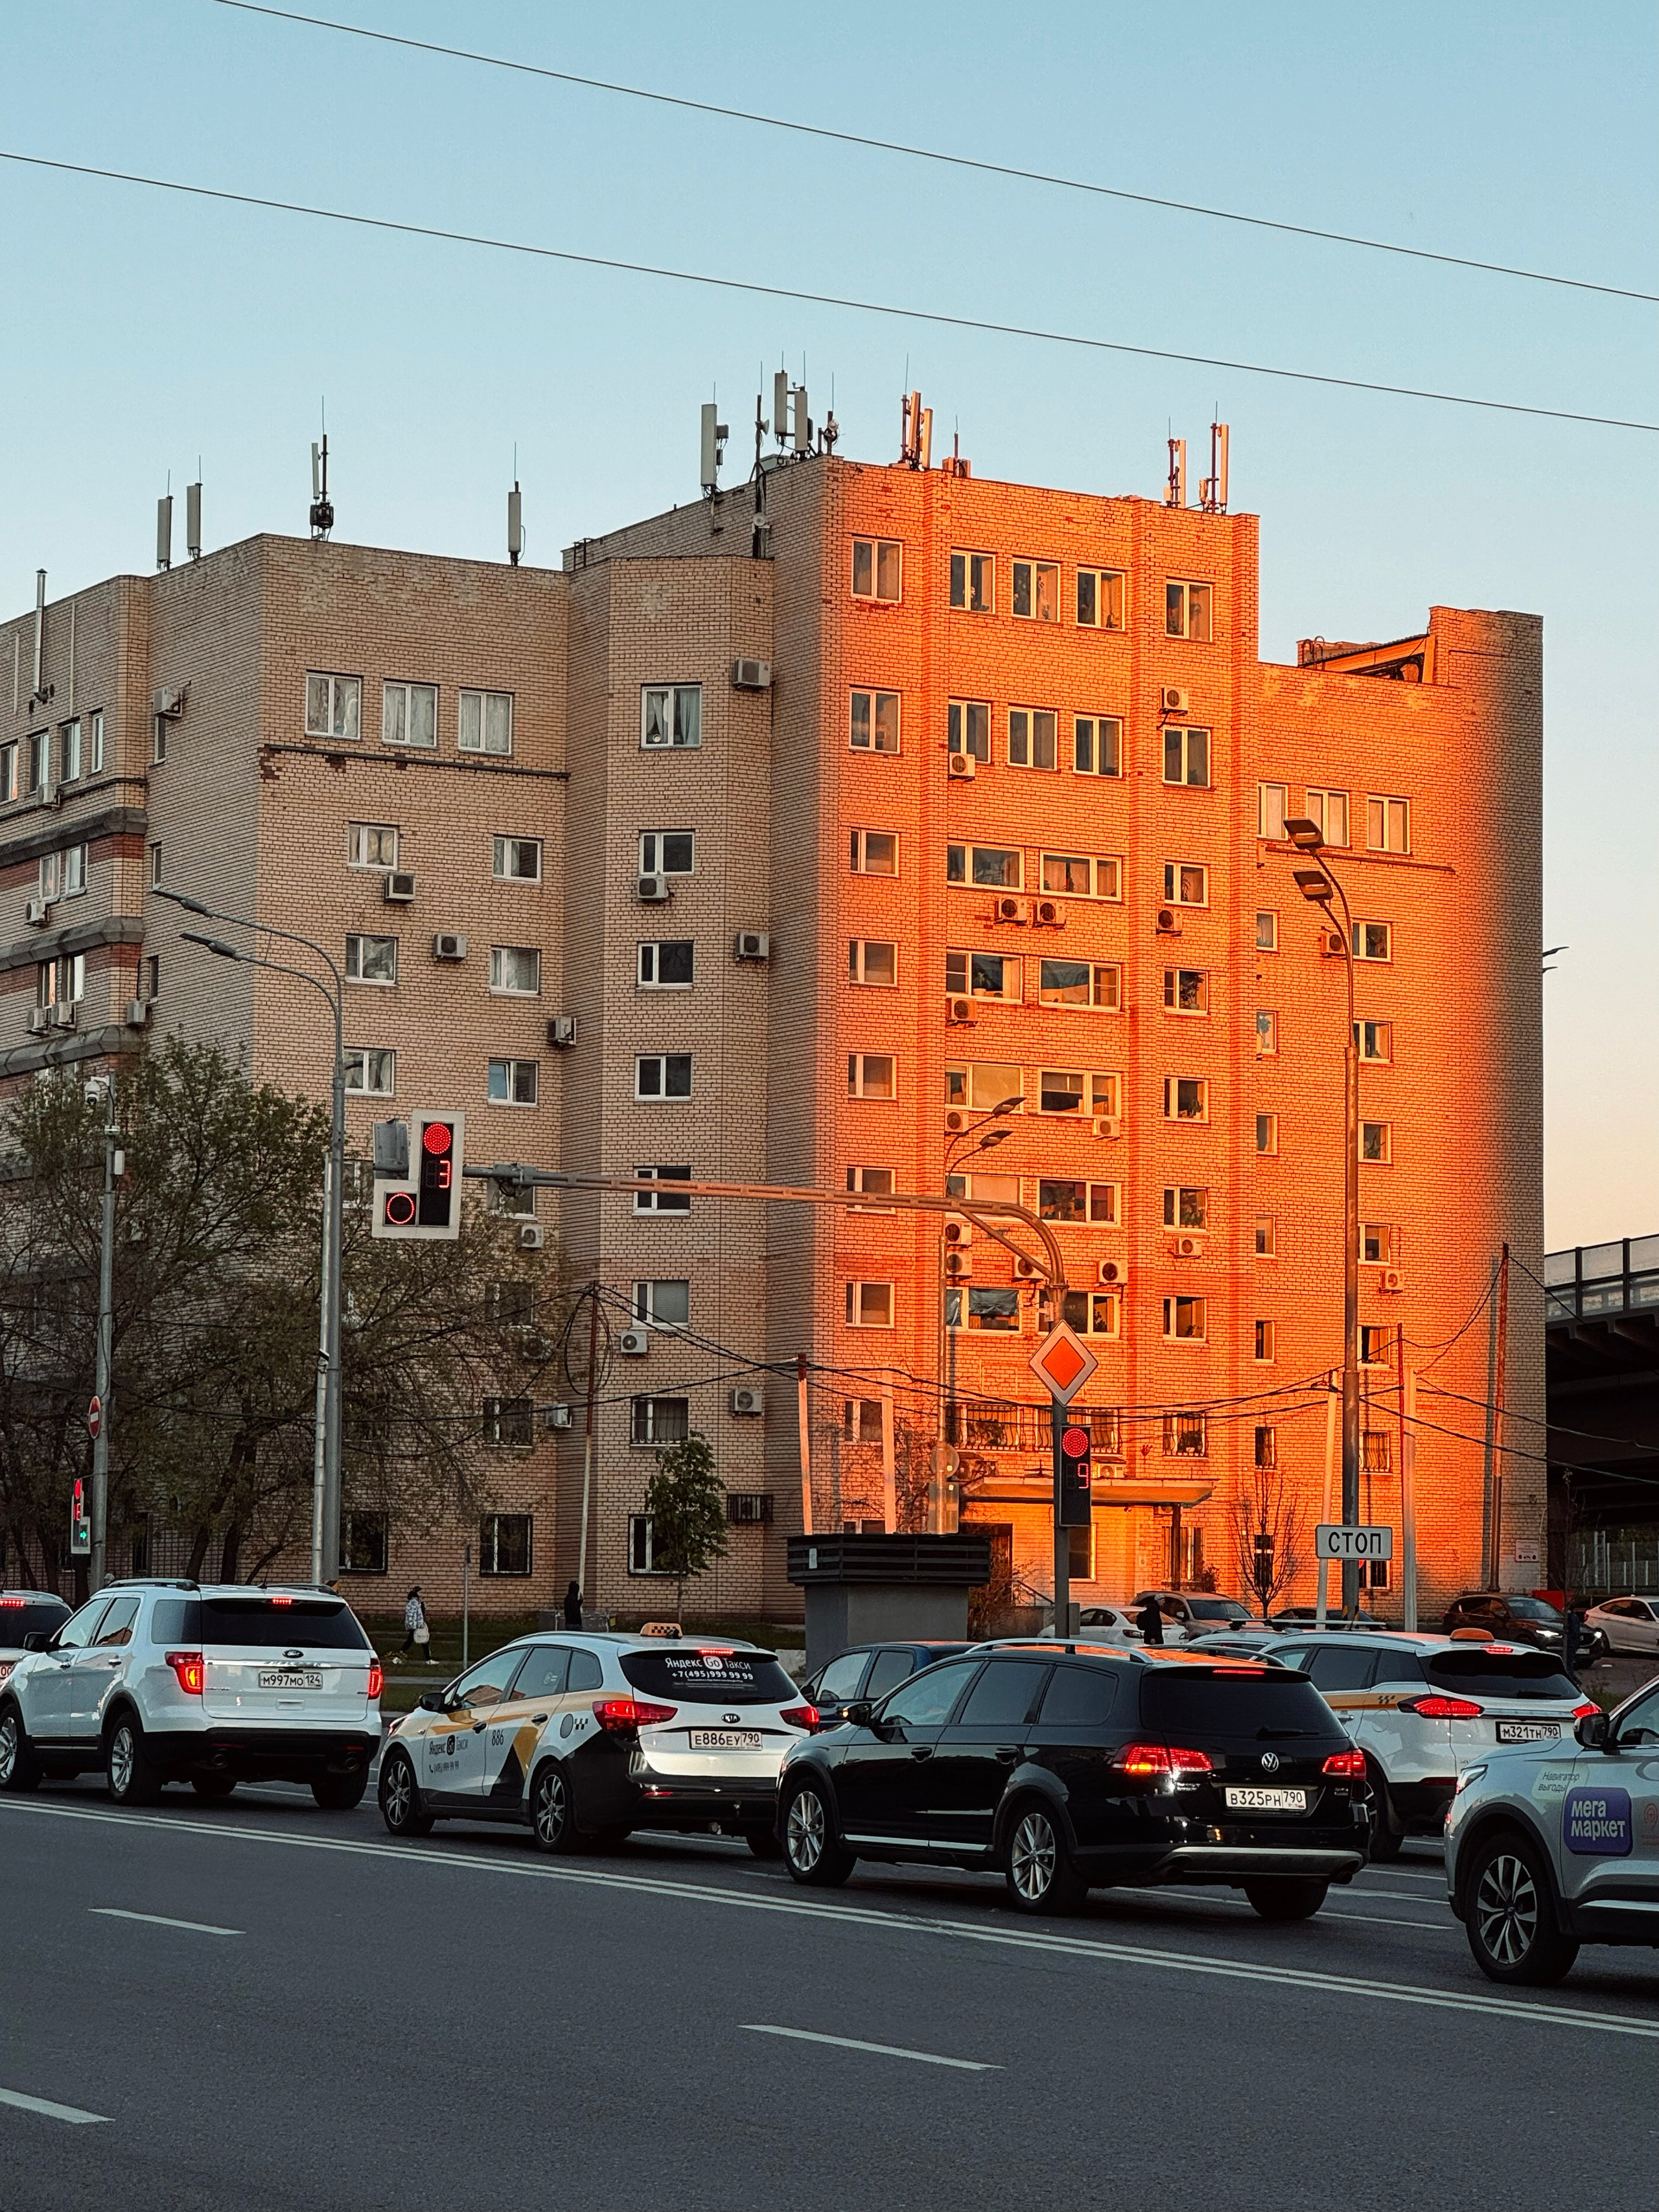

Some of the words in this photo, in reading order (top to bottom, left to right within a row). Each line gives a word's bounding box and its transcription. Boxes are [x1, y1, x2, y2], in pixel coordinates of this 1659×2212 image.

[438, 1159, 451, 1189] 3
[1077, 1463, 1089, 1489] 9
[1328, 1531, 1382, 1554] СТОП
[664, 1657, 702, 1669] Яндекс
[704, 1657, 721, 1668] Go
[722, 1657, 752, 1670] Такси
[263, 1675, 303, 1686] М997МО
[305, 1675, 320, 1684] 124
[491, 1729, 504, 1746] 886
[695, 1732, 740, 1745] Е886ЕУ
[741, 1733, 760, 1743] 790
[1503, 1726, 1542, 1739] М321ТН
[1542, 1727, 1558, 1736] 790
[1542, 1772, 1580, 1782] Навигатор
[1538, 1783, 1566, 1793] выгоды
[1231, 1790, 1281, 1806] В325РН
[1282, 1791, 1303, 1804] 790
[1571, 1800, 1607, 1817] мега
[1571, 1819, 1626, 1841] маркет
